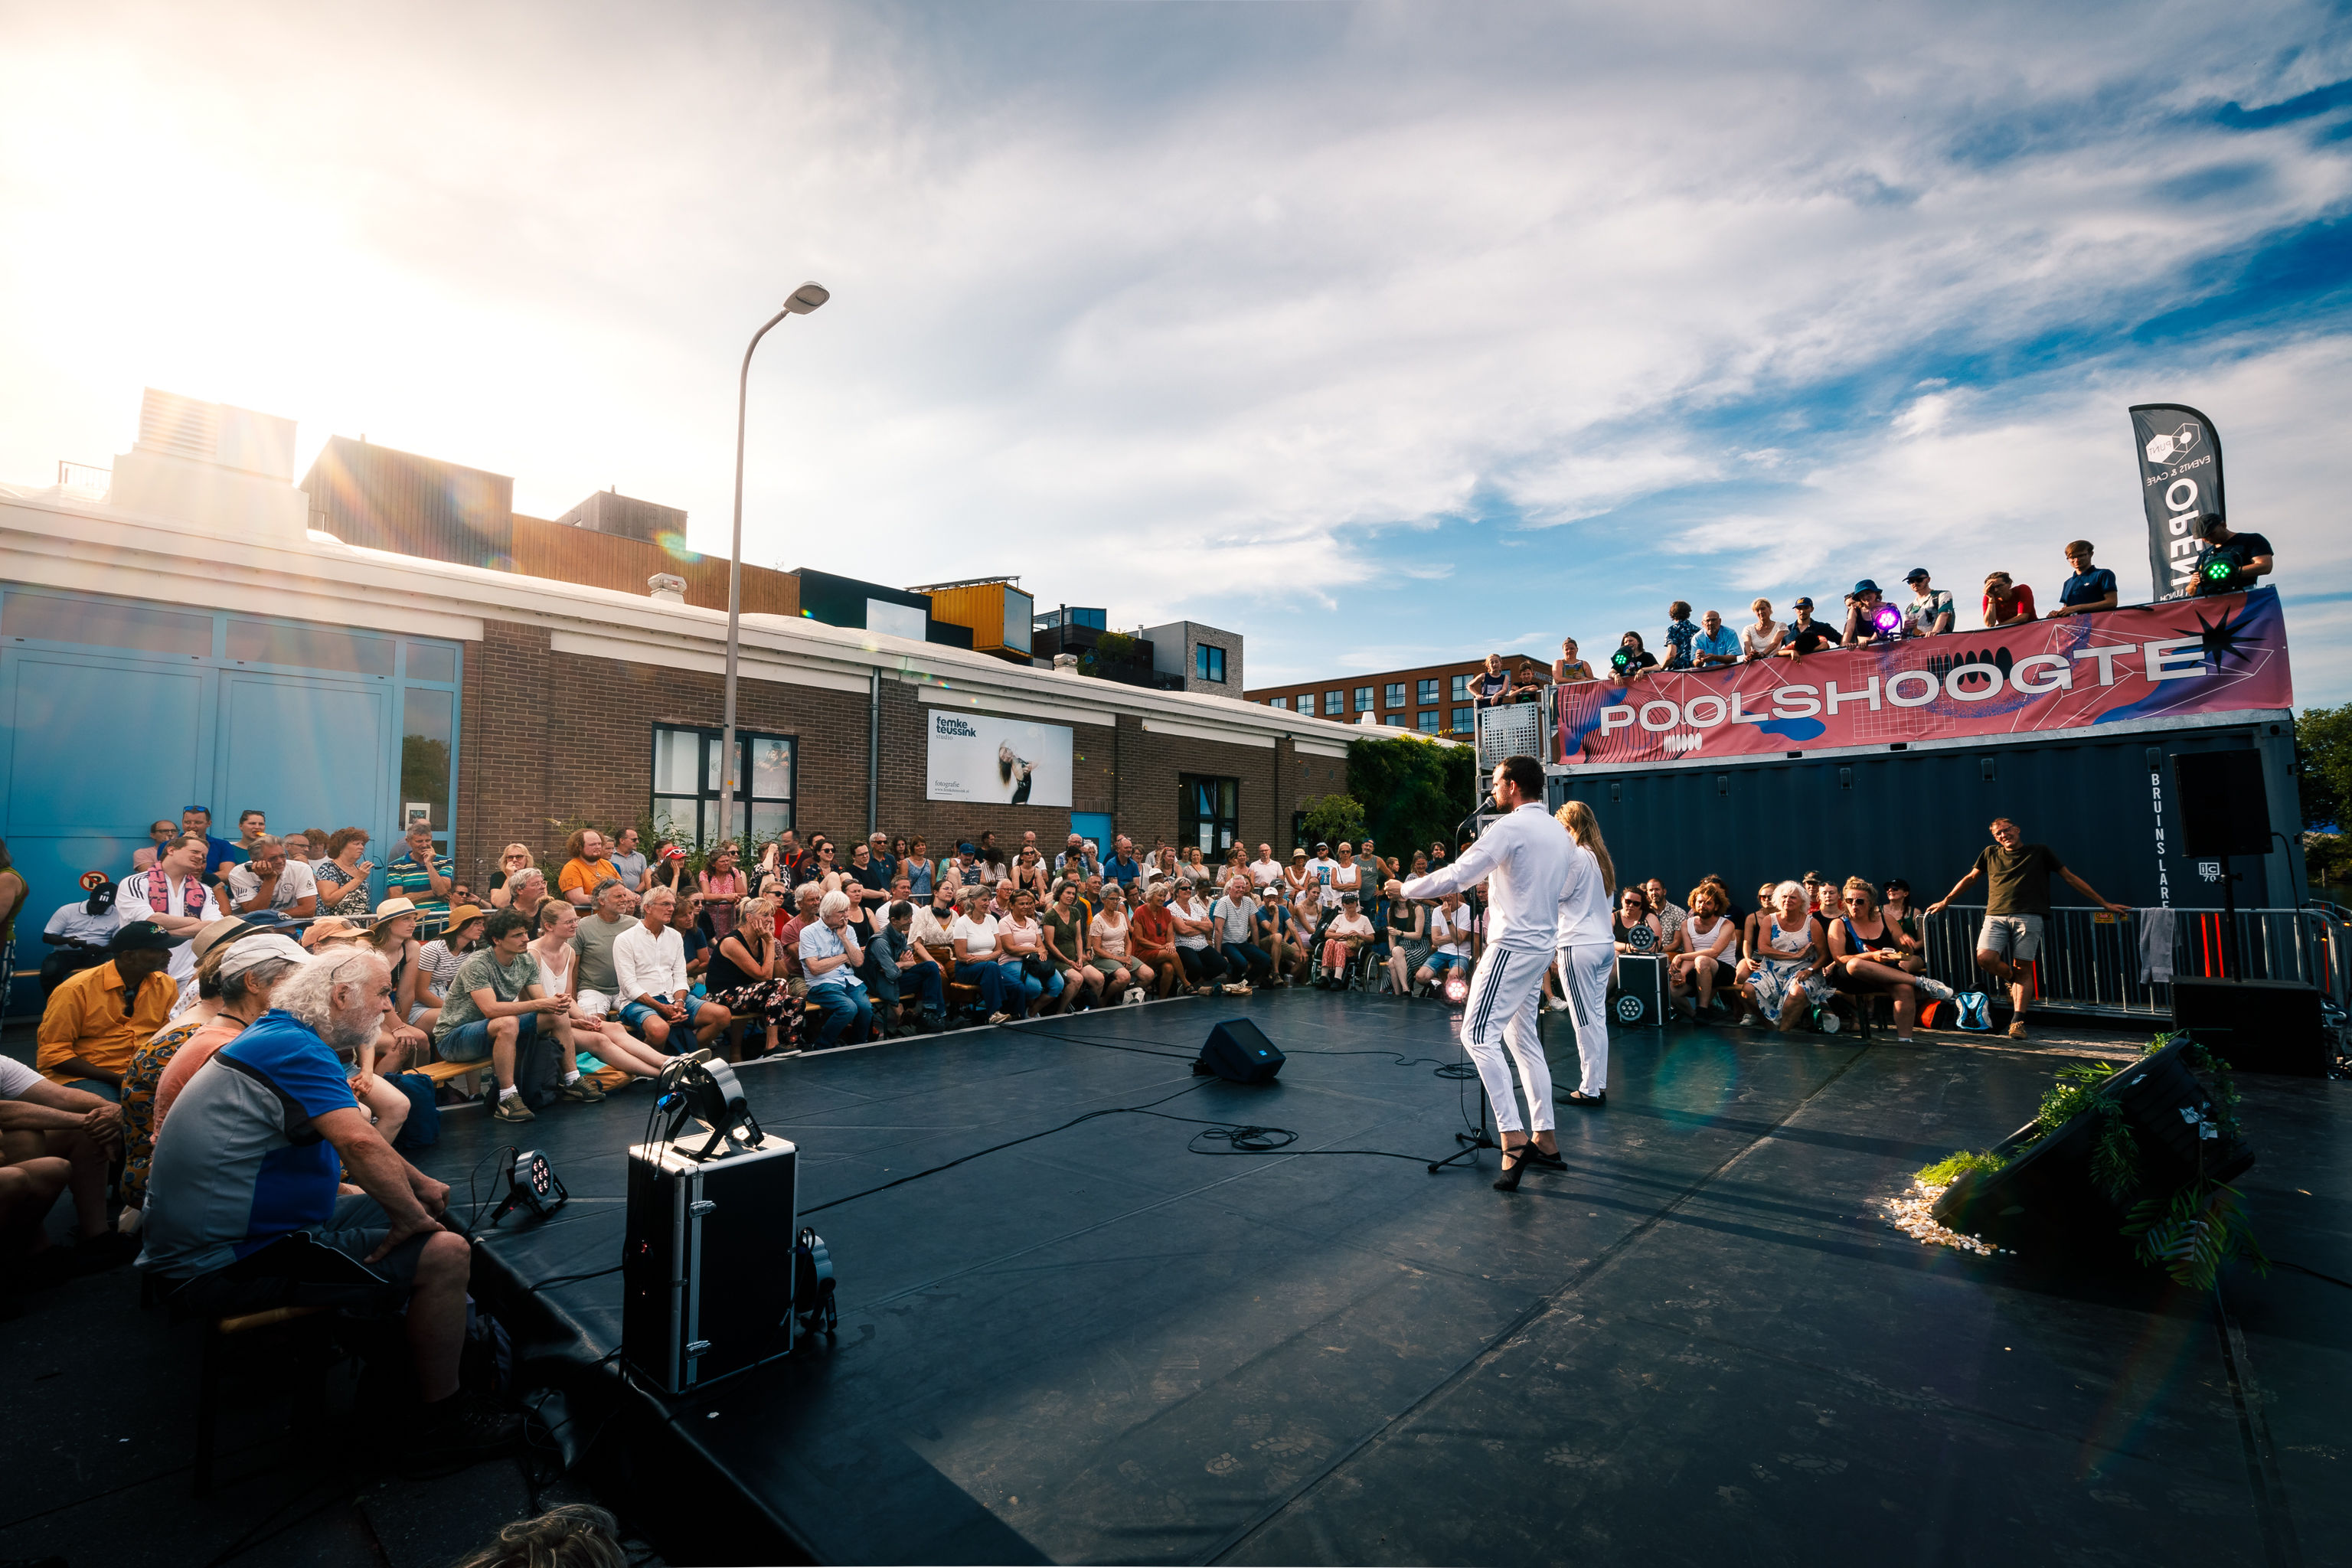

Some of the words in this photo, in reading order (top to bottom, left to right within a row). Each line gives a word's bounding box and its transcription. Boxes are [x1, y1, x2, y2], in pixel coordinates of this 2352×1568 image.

[1599, 635, 2207, 737] POOLSHOOGTE
[936, 716, 968, 729] femke
[936, 724, 976, 737] teussink
[935, 779, 960, 788] fotografie
